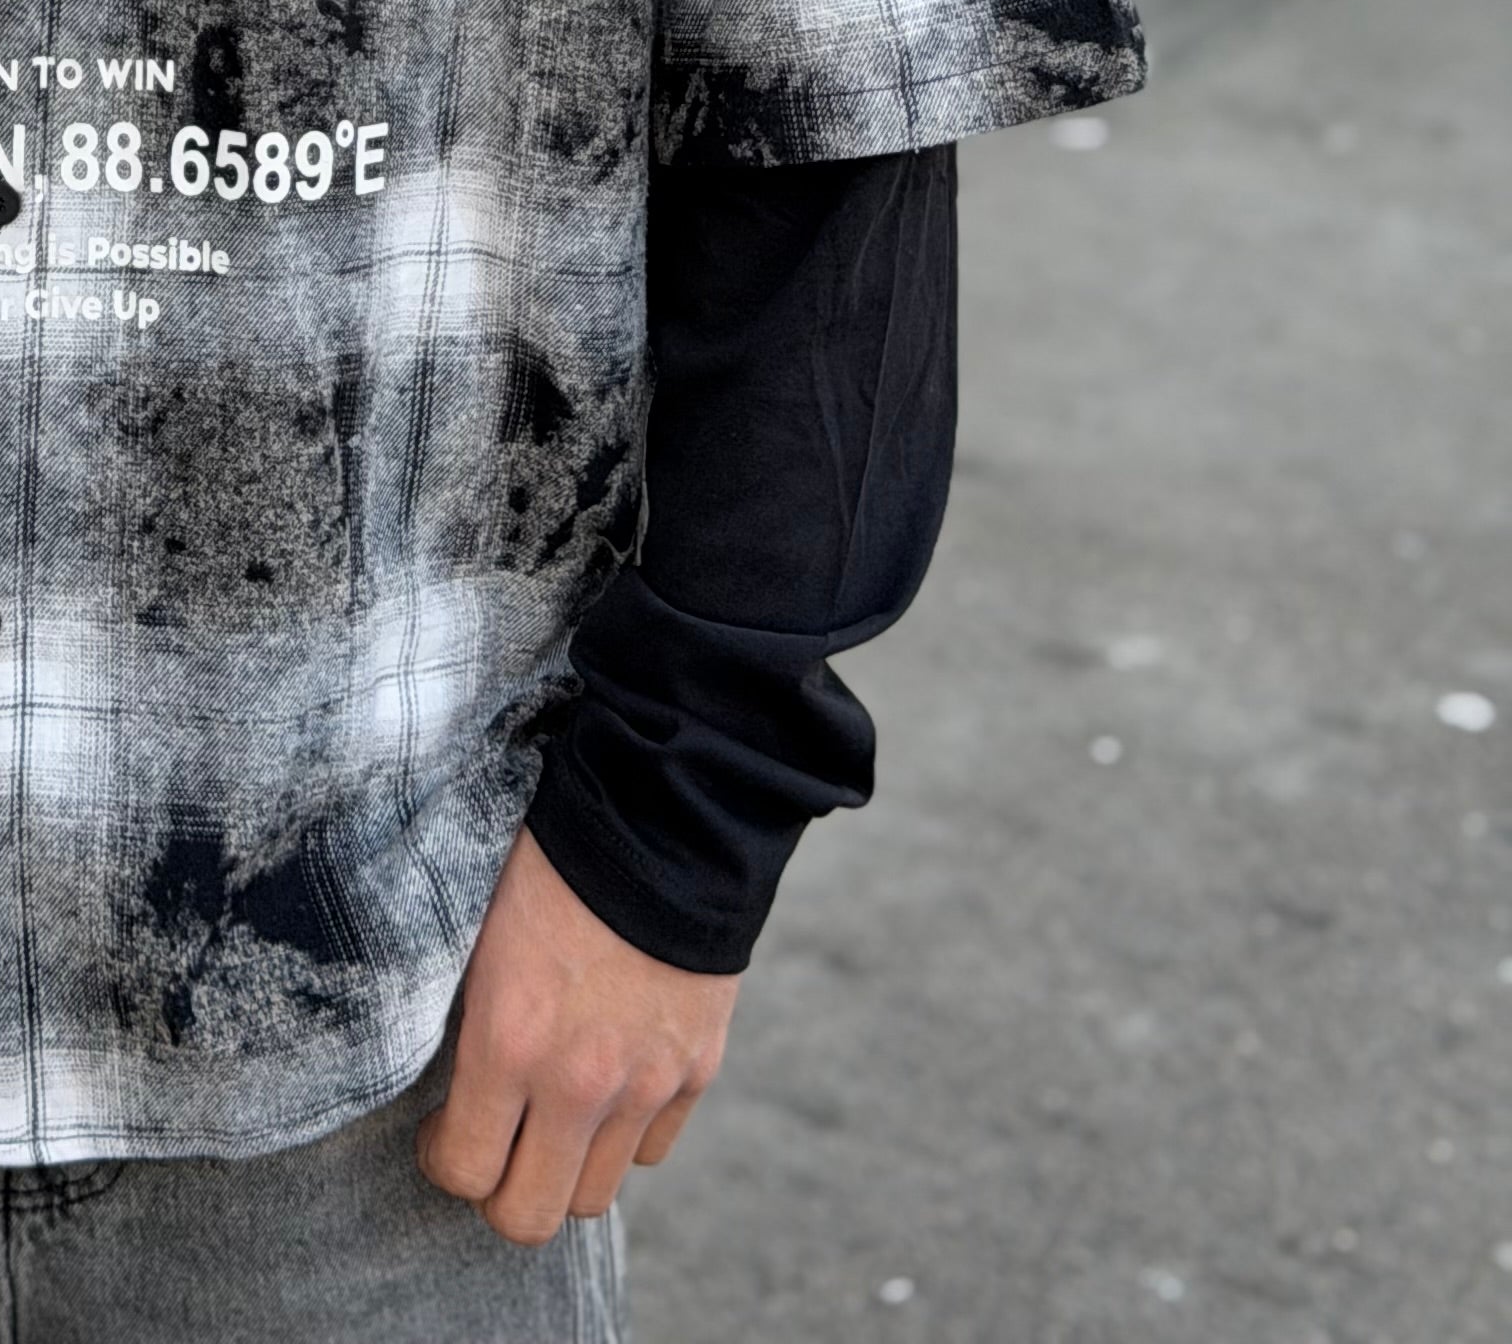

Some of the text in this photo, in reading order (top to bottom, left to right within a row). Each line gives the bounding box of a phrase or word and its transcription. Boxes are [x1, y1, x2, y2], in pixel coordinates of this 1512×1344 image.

[32, 56, 83, 89] TO
[97, 58, 175, 92] WIN
[48, 232, 76, 266] is
[89, 235, 231, 275] Possible
[24, 286, 104, 321] Give
[112, 289, 161, 329] Up
